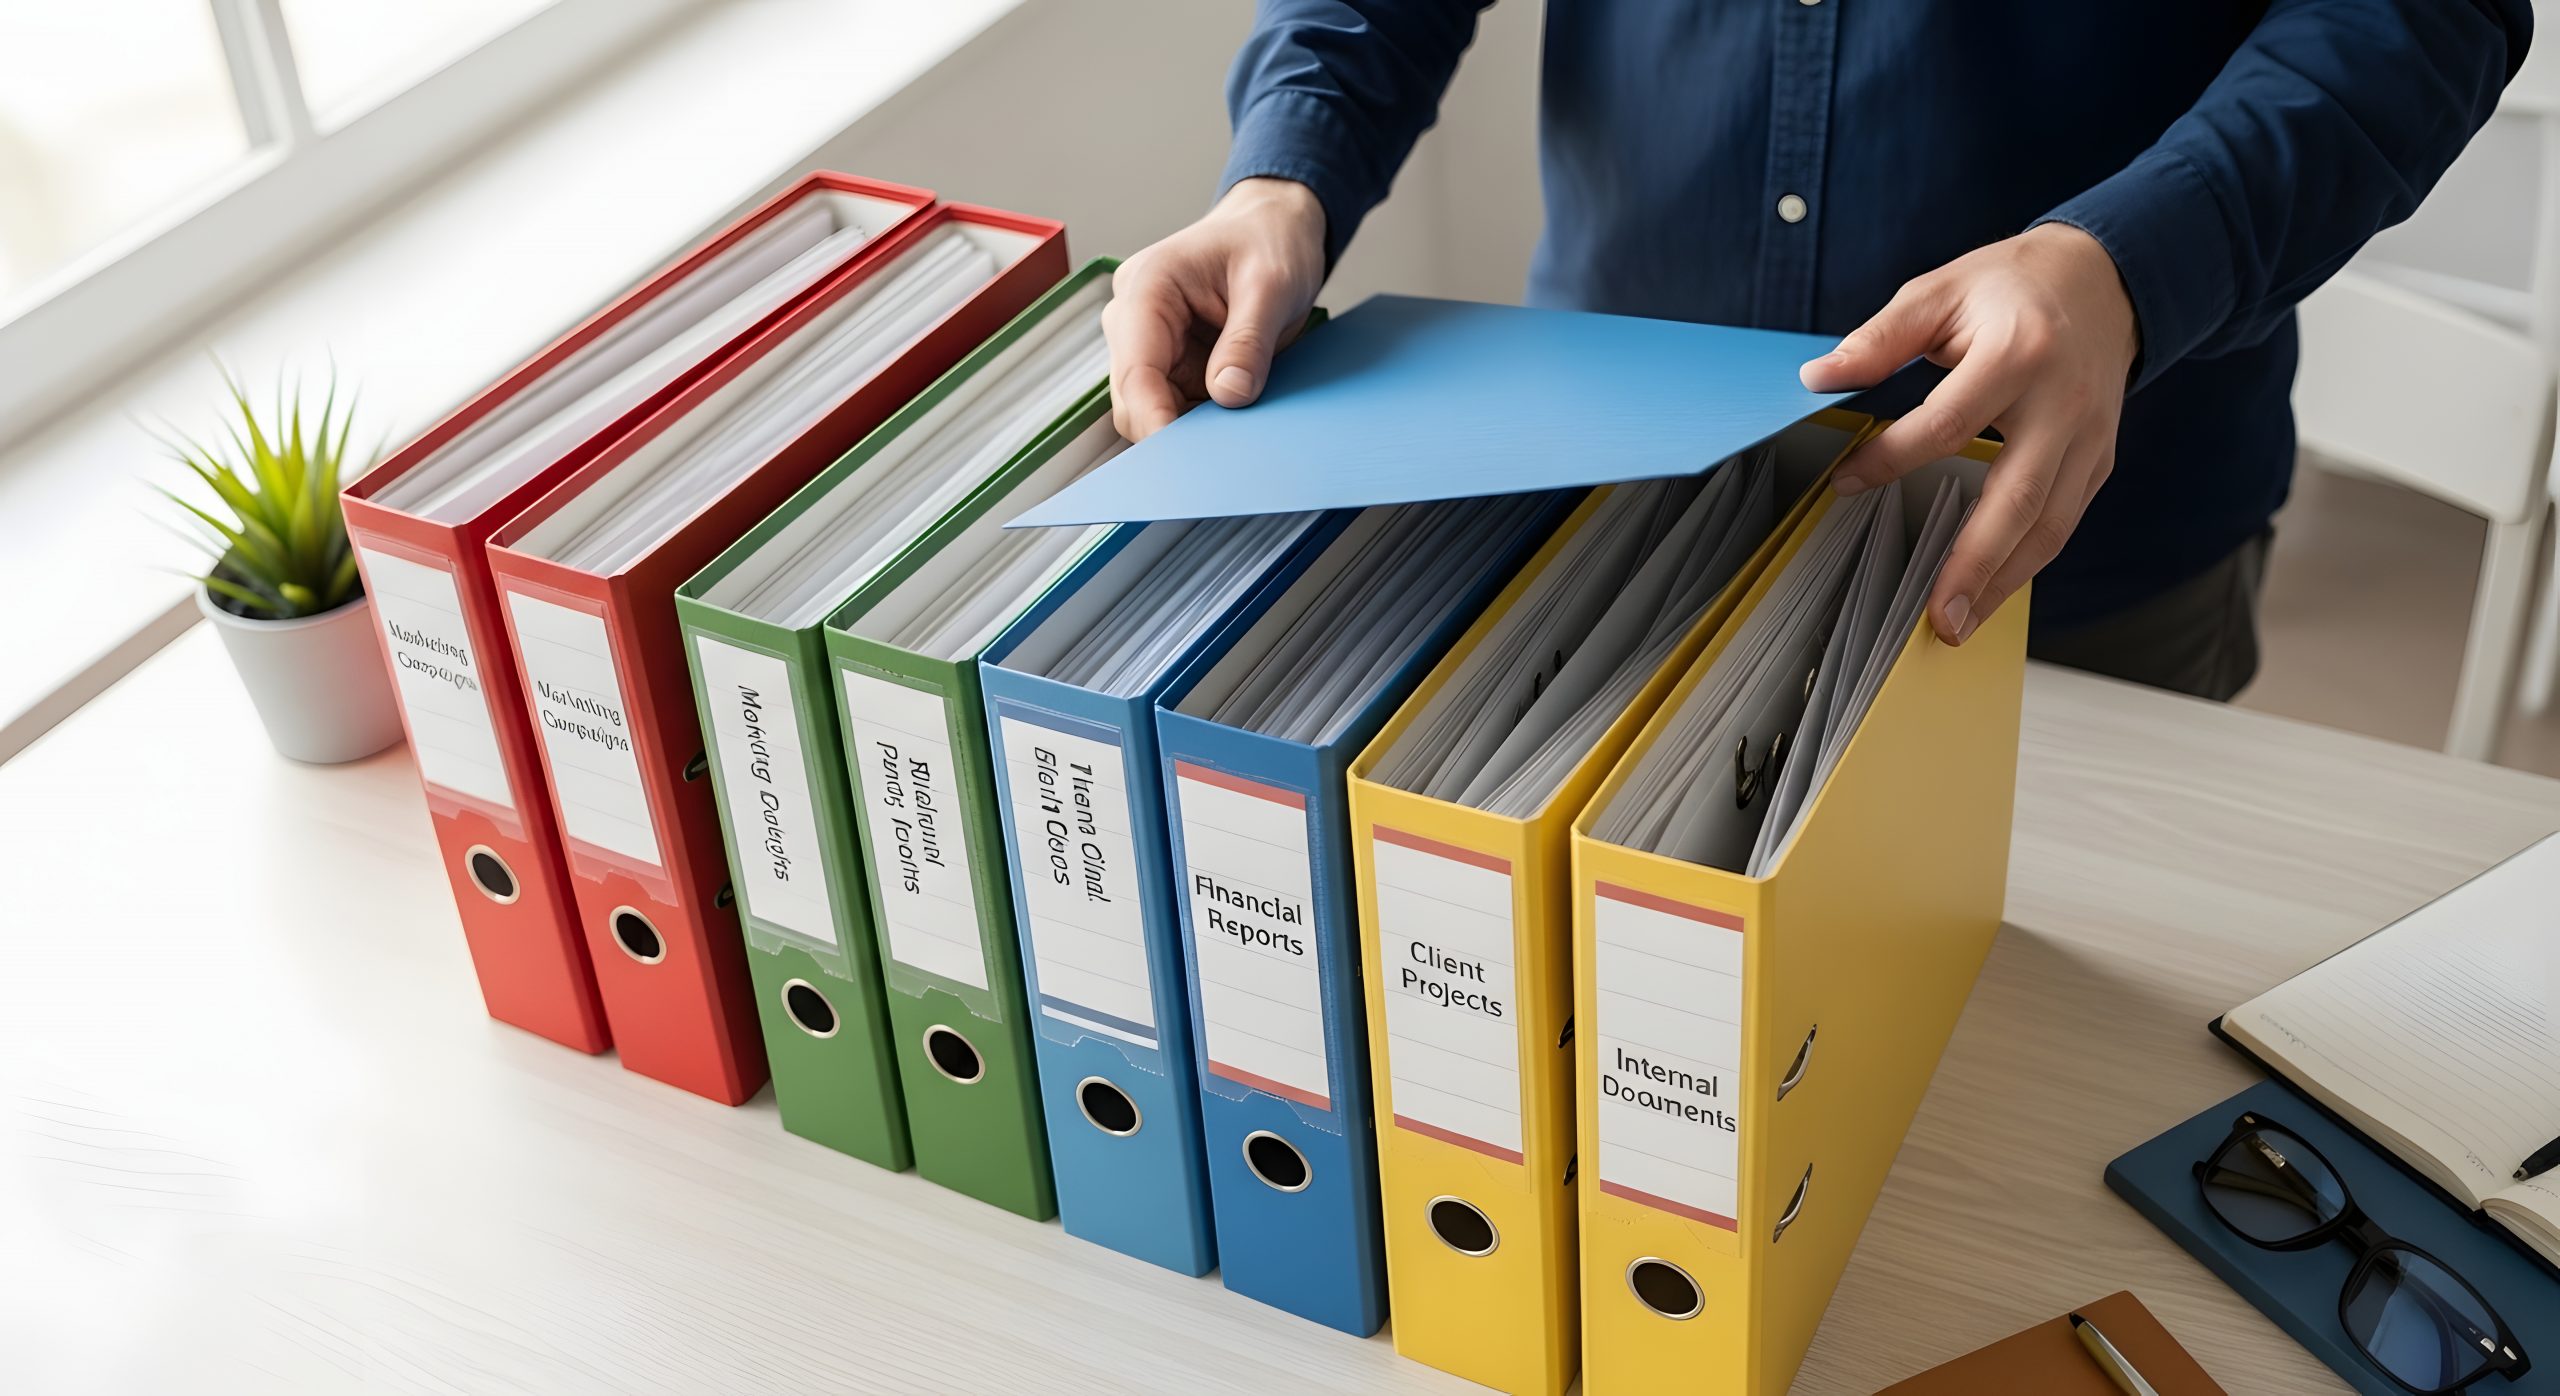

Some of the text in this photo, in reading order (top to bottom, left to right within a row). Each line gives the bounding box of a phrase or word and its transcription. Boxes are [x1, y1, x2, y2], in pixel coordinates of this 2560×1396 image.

[1195, 874, 1303, 926] Financial
[1207, 907, 1304, 957] Reports
[1410, 941, 1486, 984] Client
[1401, 967, 1503, 1018] Projects
[1616, 1047, 1718, 1098] Internal
[1602, 1074, 1736, 1133] Documents
